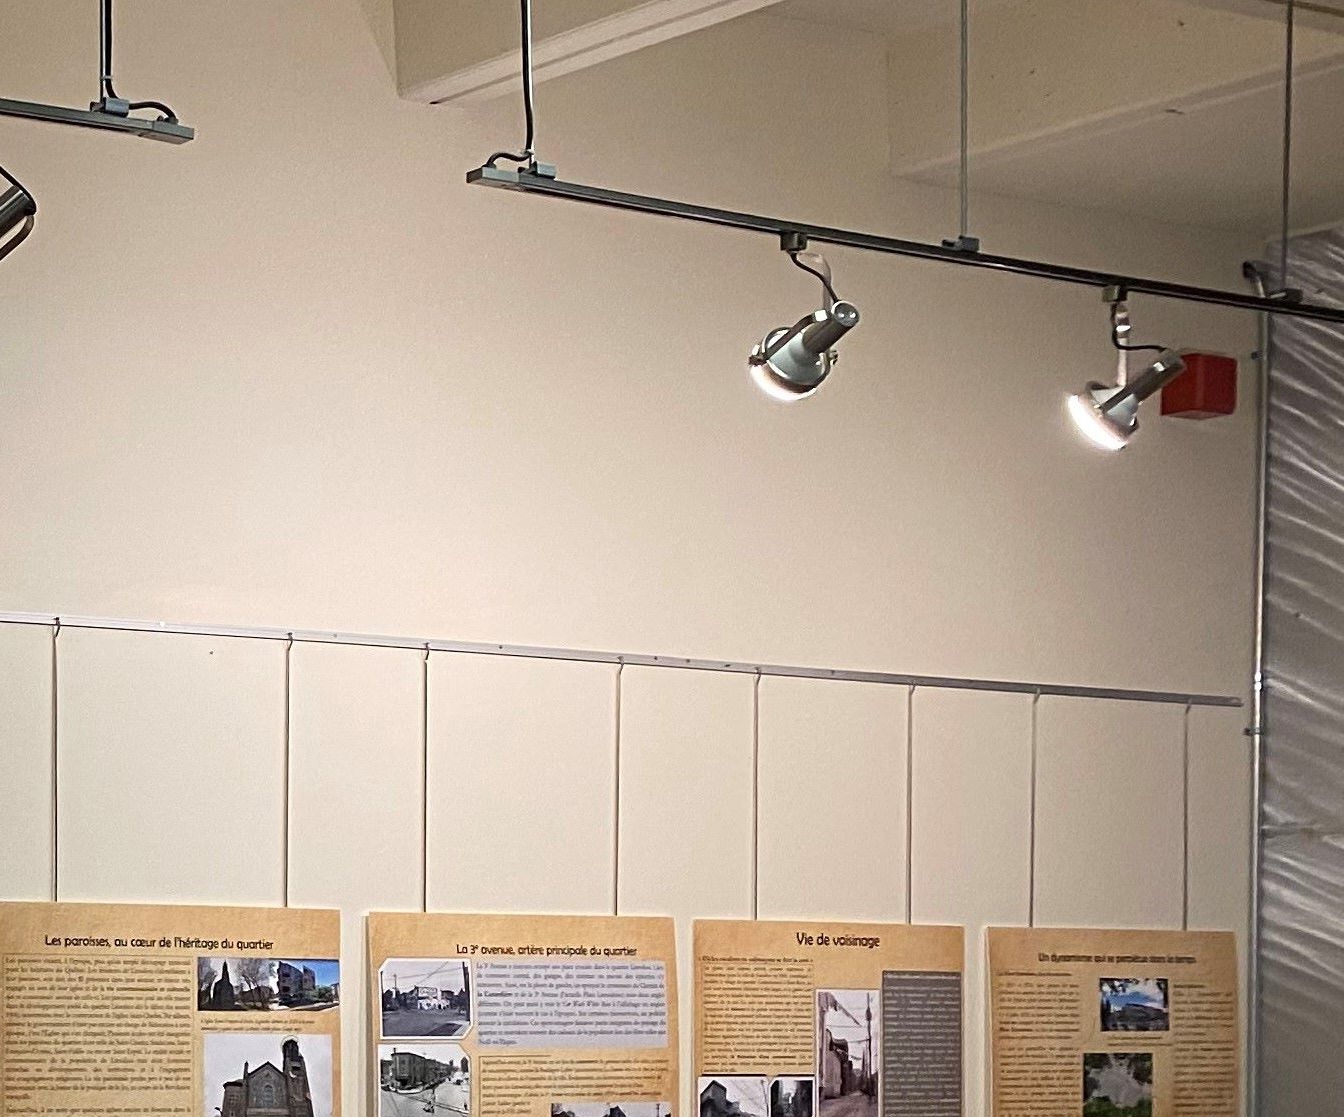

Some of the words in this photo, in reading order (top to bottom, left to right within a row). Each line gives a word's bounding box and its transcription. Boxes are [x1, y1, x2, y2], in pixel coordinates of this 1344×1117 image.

[45, 935, 61, 946] Les
[65, 936, 111, 947] paroisses,
[114, 938, 127, 947] au
[159, 937, 171, 947] de
[174, 936, 219, 950] l'héritage
[221, 938, 234, 948] du
[237, 939, 273, 950] quartier
[796, 932, 814, 945] Vie
[816, 933, 830, 946] de
[833, 935, 880, 948] voisinage
[456, 944, 468, 954] La
[590, 946, 601, 955] du
[603, 946, 638, 957] quartier
